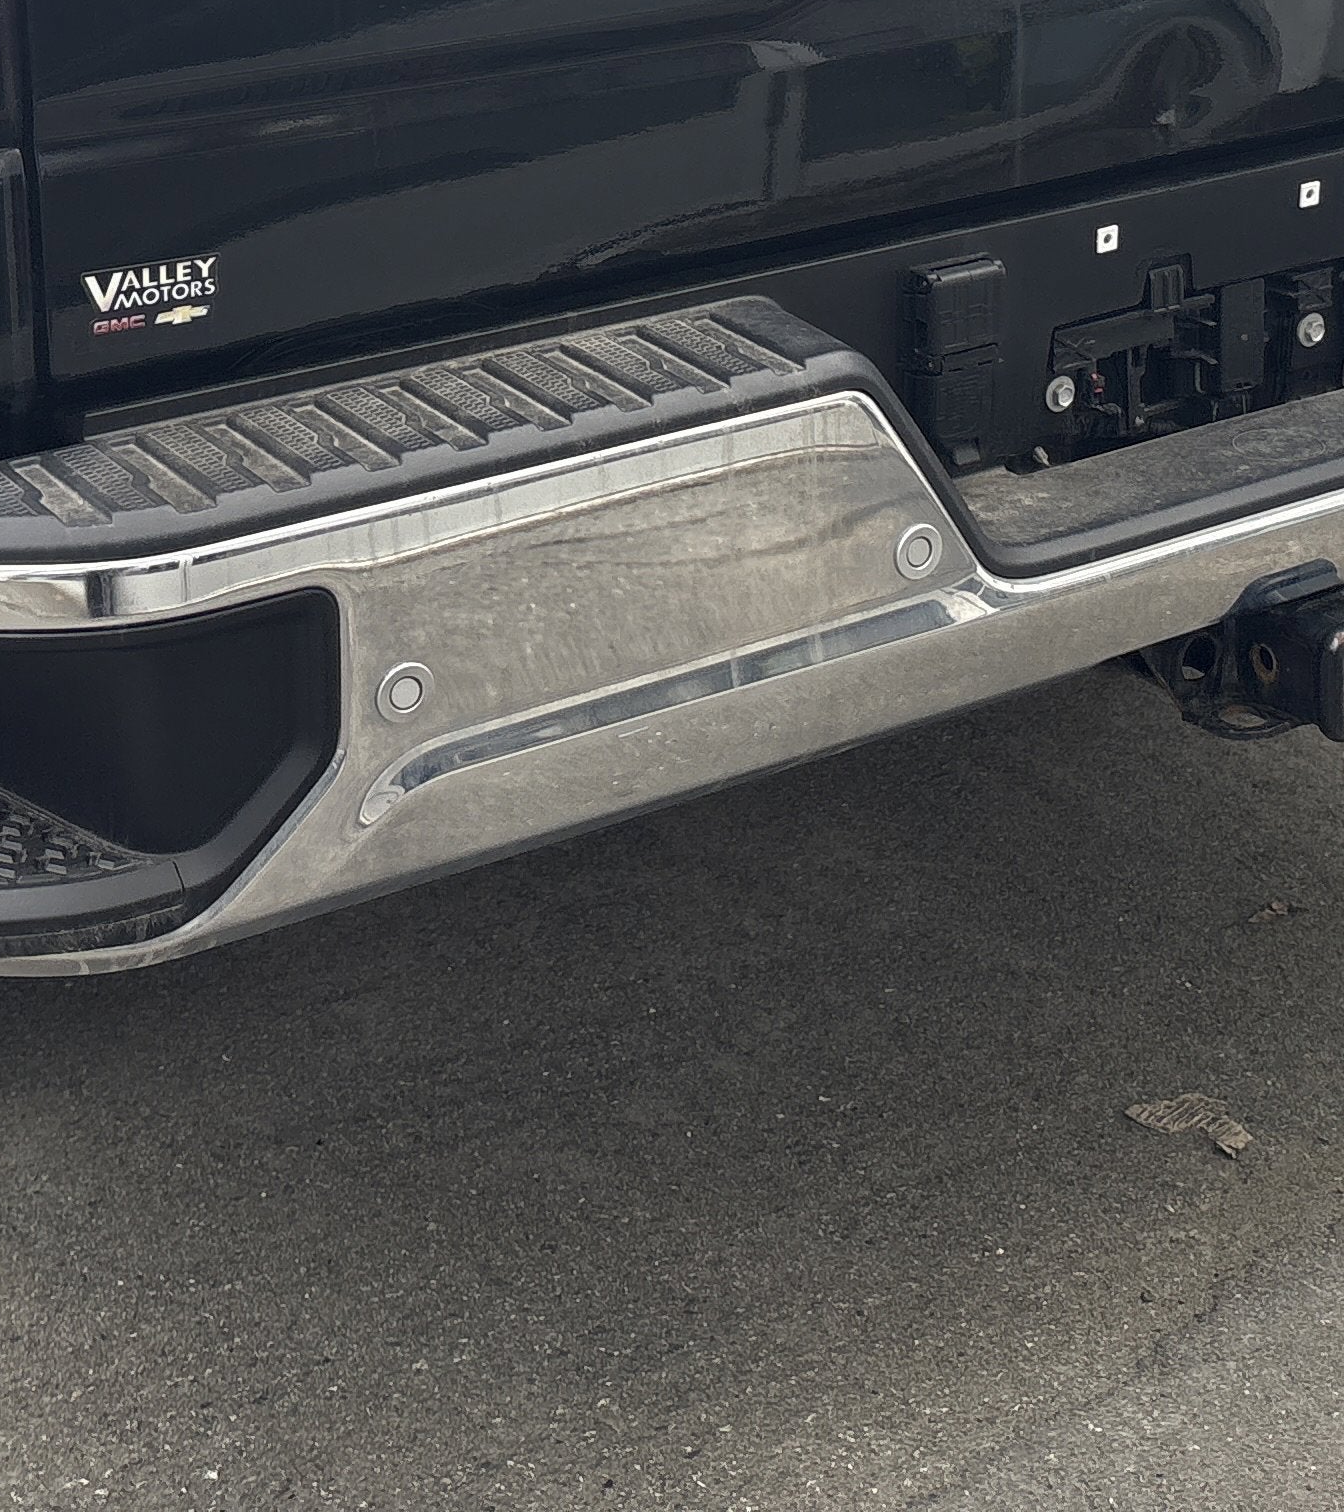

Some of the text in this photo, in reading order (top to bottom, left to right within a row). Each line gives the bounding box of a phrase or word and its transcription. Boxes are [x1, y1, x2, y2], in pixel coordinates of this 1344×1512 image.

[84, 256, 217, 313] VALLEY
[113, 277, 216, 311] MOTORS
[93, 314, 146, 336] GMC
